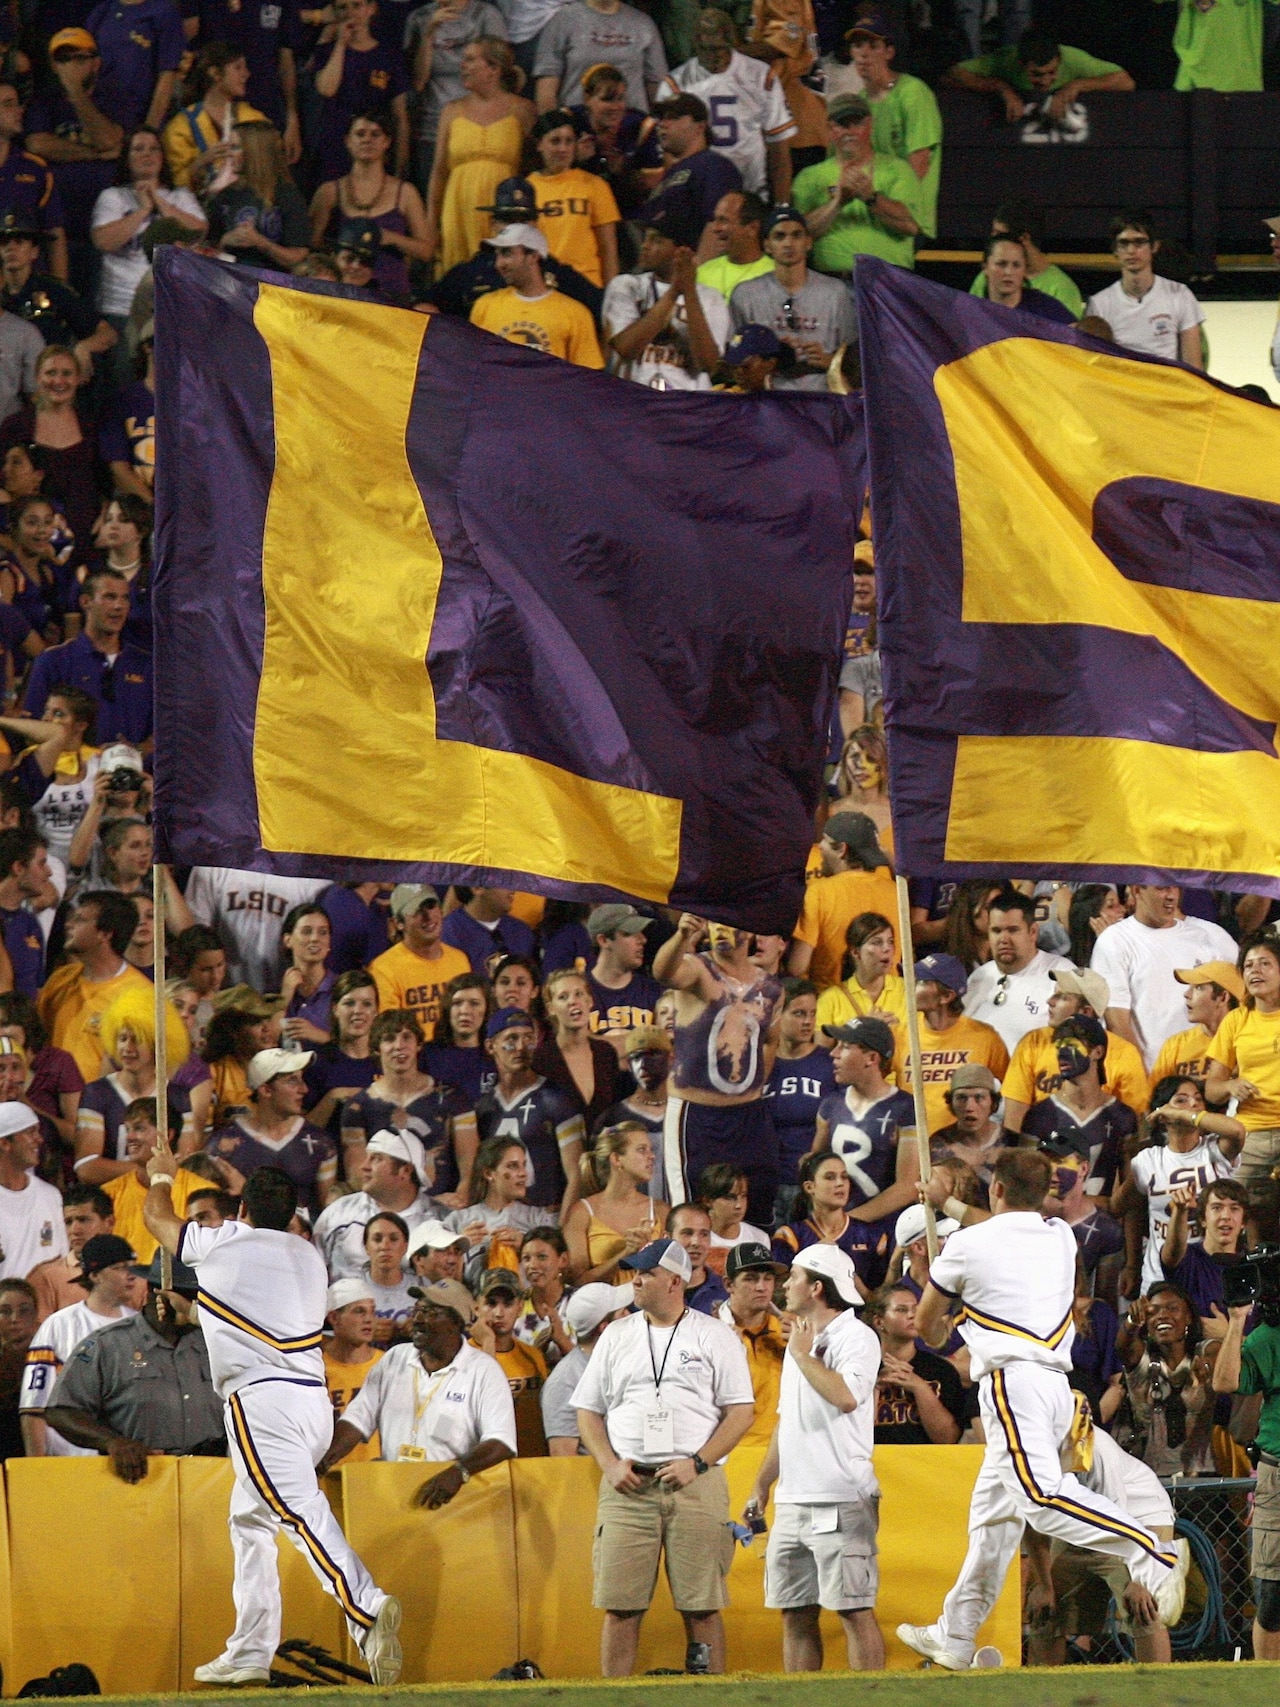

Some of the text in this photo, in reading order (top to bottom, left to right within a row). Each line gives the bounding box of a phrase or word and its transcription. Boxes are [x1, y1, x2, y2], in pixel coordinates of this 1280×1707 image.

[710, 96, 739, 148] 5
[541, 197, 591, 217] SU
[227, 891, 289, 917] LSU
[1025, 995, 1040, 1015] LSU
[589, 1005, 655, 1033] LSU
[762, 1076, 822, 1099] LSU
[446, 1390, 467, 1403] LSU
